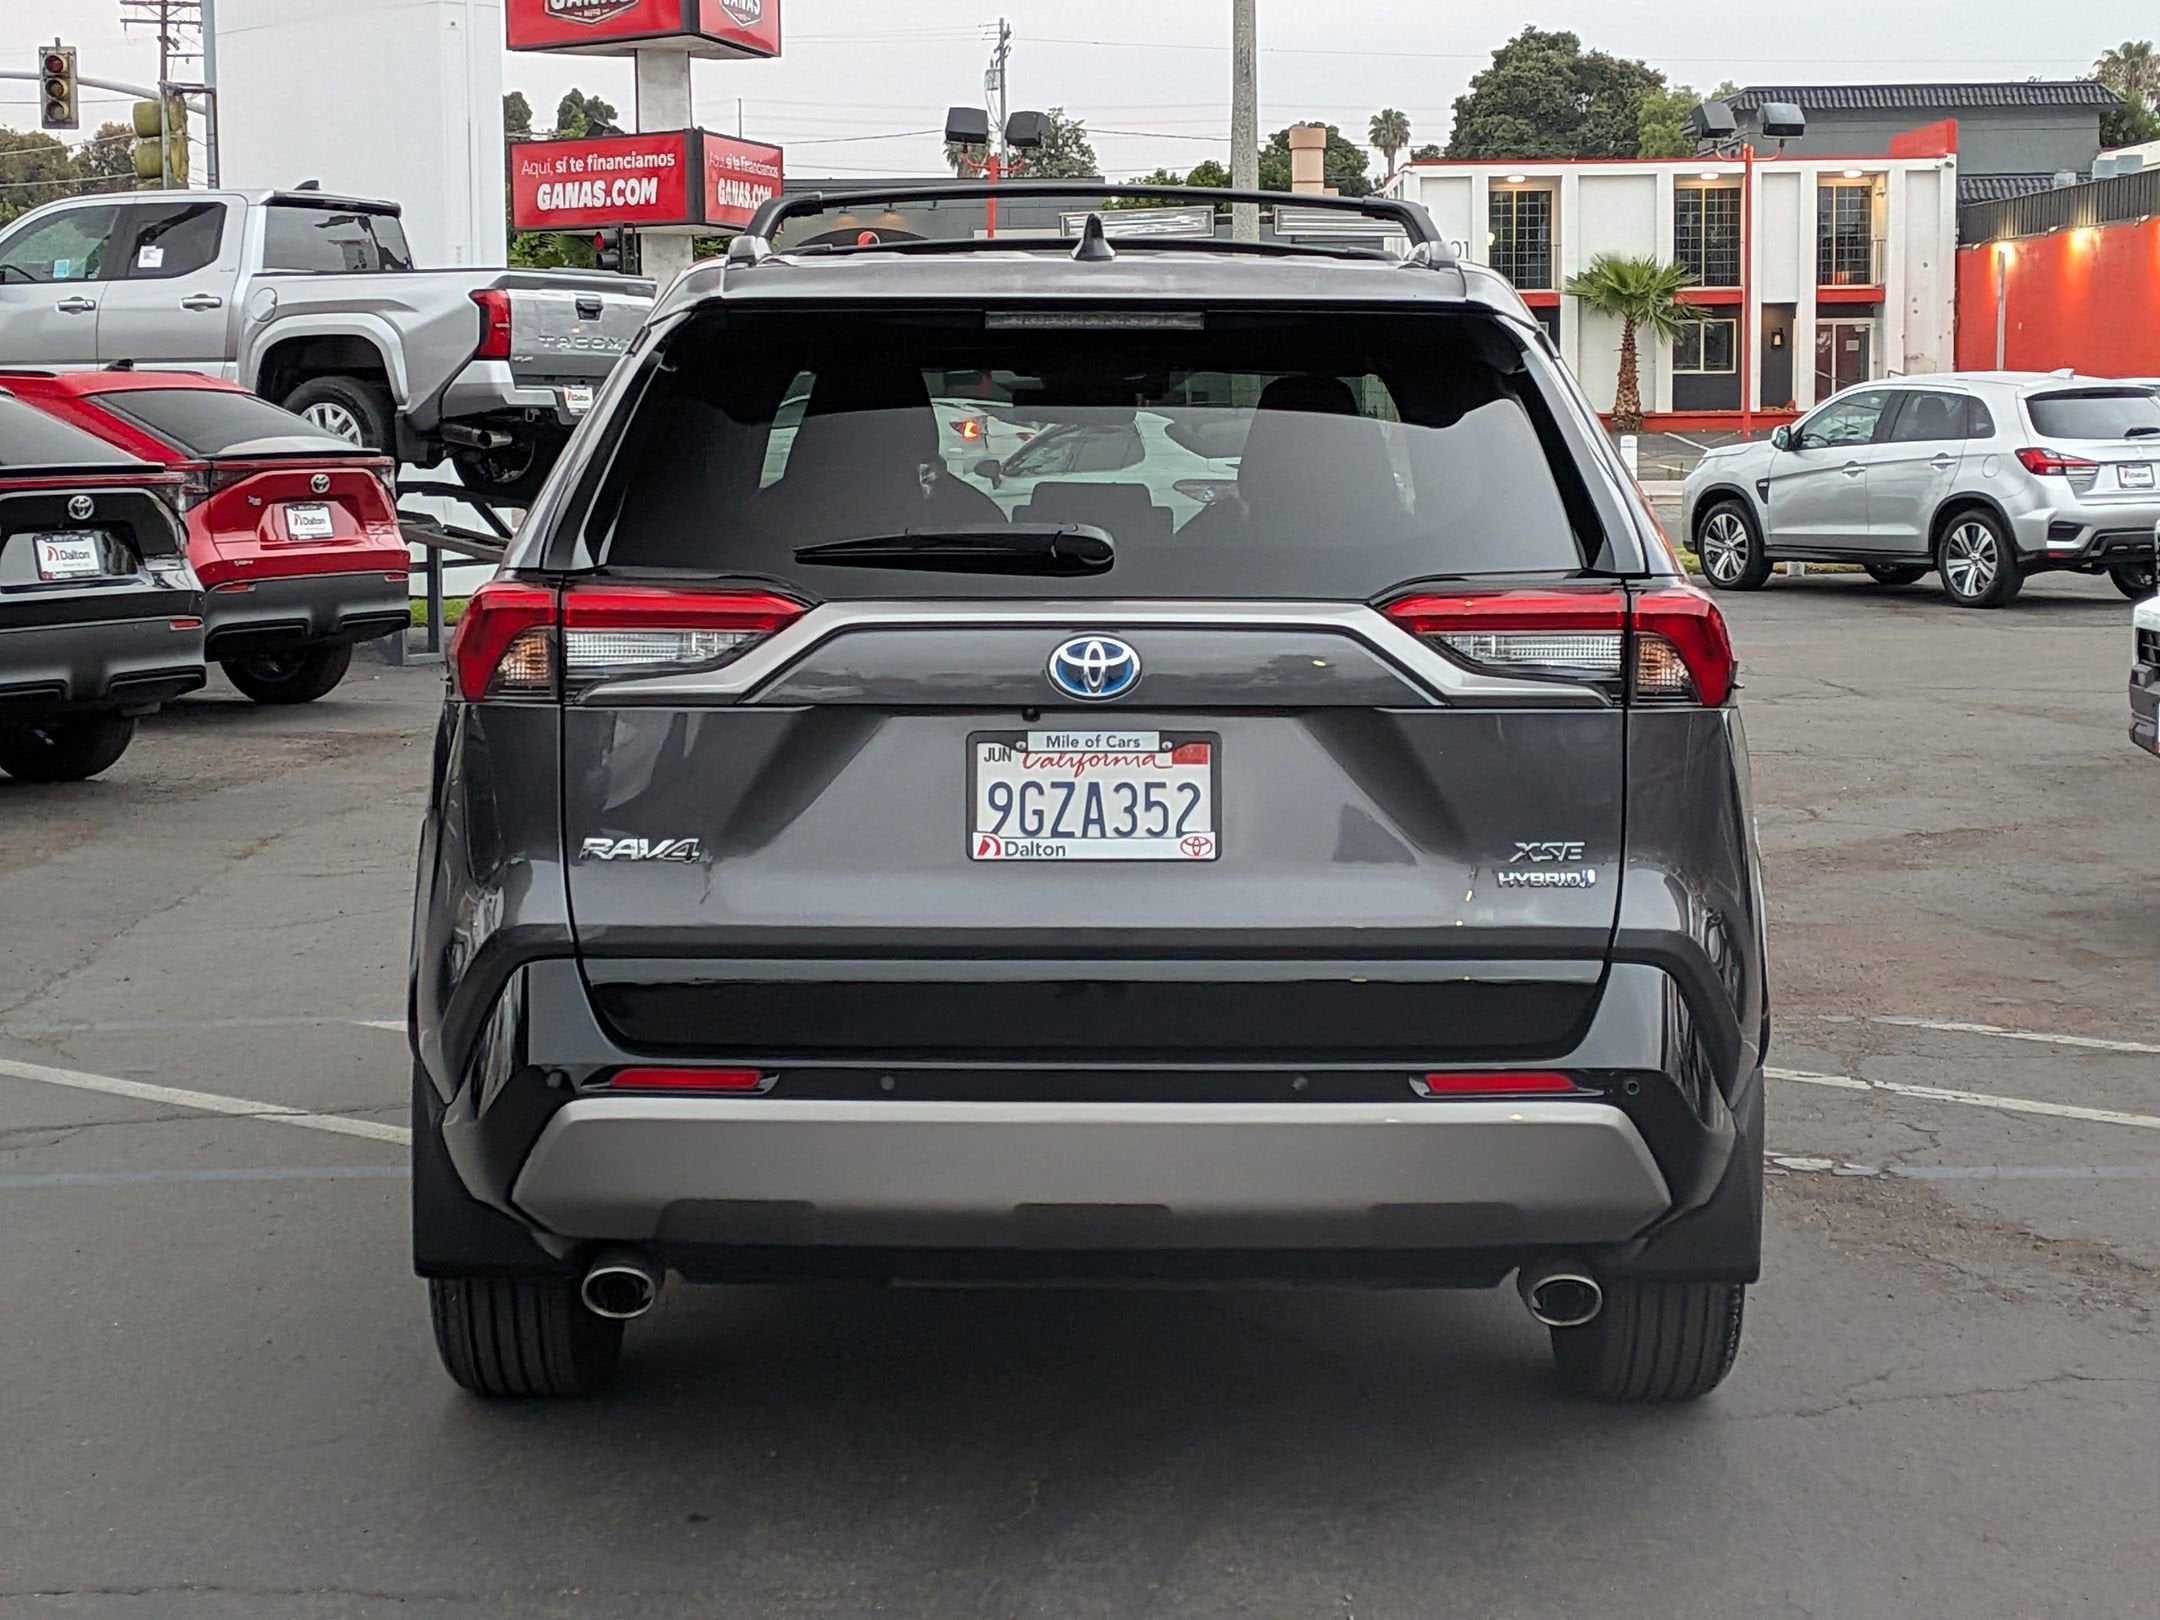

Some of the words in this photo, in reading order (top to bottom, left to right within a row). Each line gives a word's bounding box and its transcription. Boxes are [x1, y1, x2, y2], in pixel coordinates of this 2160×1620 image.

[570, 158, 584, 172] te
[587, 151, 675, 171] financiamos
[537, 177, 658, 211] GANAS.COM
[538, 335, 632, 351] TACOM
[60, 549, 90, 561] Dalton
[1046, 735, 1080, 749] Mile
[1084, 734, 1101, 748] of
[1106, 735, 1141, 749] Cars
[983, 747, 1012, 762] JUN
[1022, 751, 1173, 778] California
[987, 780, 1202, 838] 9GZA352
[579, 837, 700, 864] RAV4
[1004, 840, 1067, 857] Dalton
[1508, 841, 1586, 863] XSE
[1498, 871, 1582, 888] HYBRID
